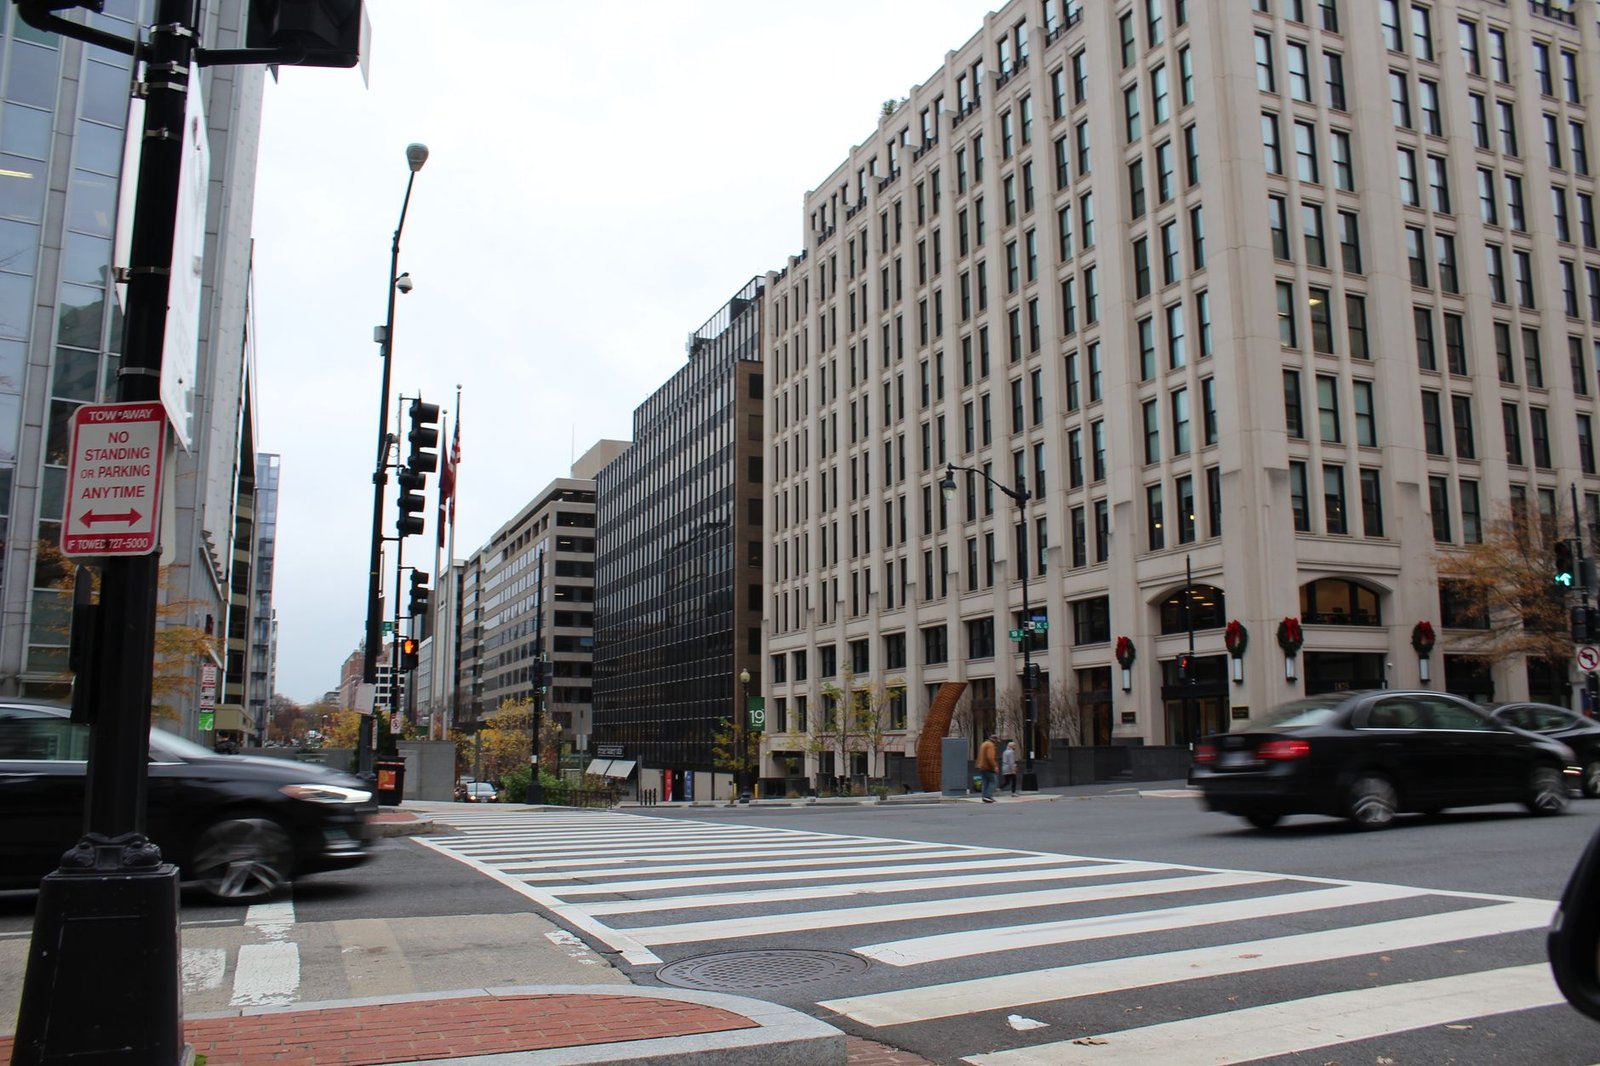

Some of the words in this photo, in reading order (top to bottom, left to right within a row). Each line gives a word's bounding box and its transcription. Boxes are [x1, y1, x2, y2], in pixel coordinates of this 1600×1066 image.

[108, 431, 129, 443] NO
[84, 447, 150, 461] STANDING
[80, 469, 94, 479] OR
[98, 464, 150, 478] PARKING
[81, 485, 146, 499] ANYTIME
[78, 539, 106, 550] TOWED
[109, 538, 148, 549] 727-5000
[749, 710, 765, 724] 19
